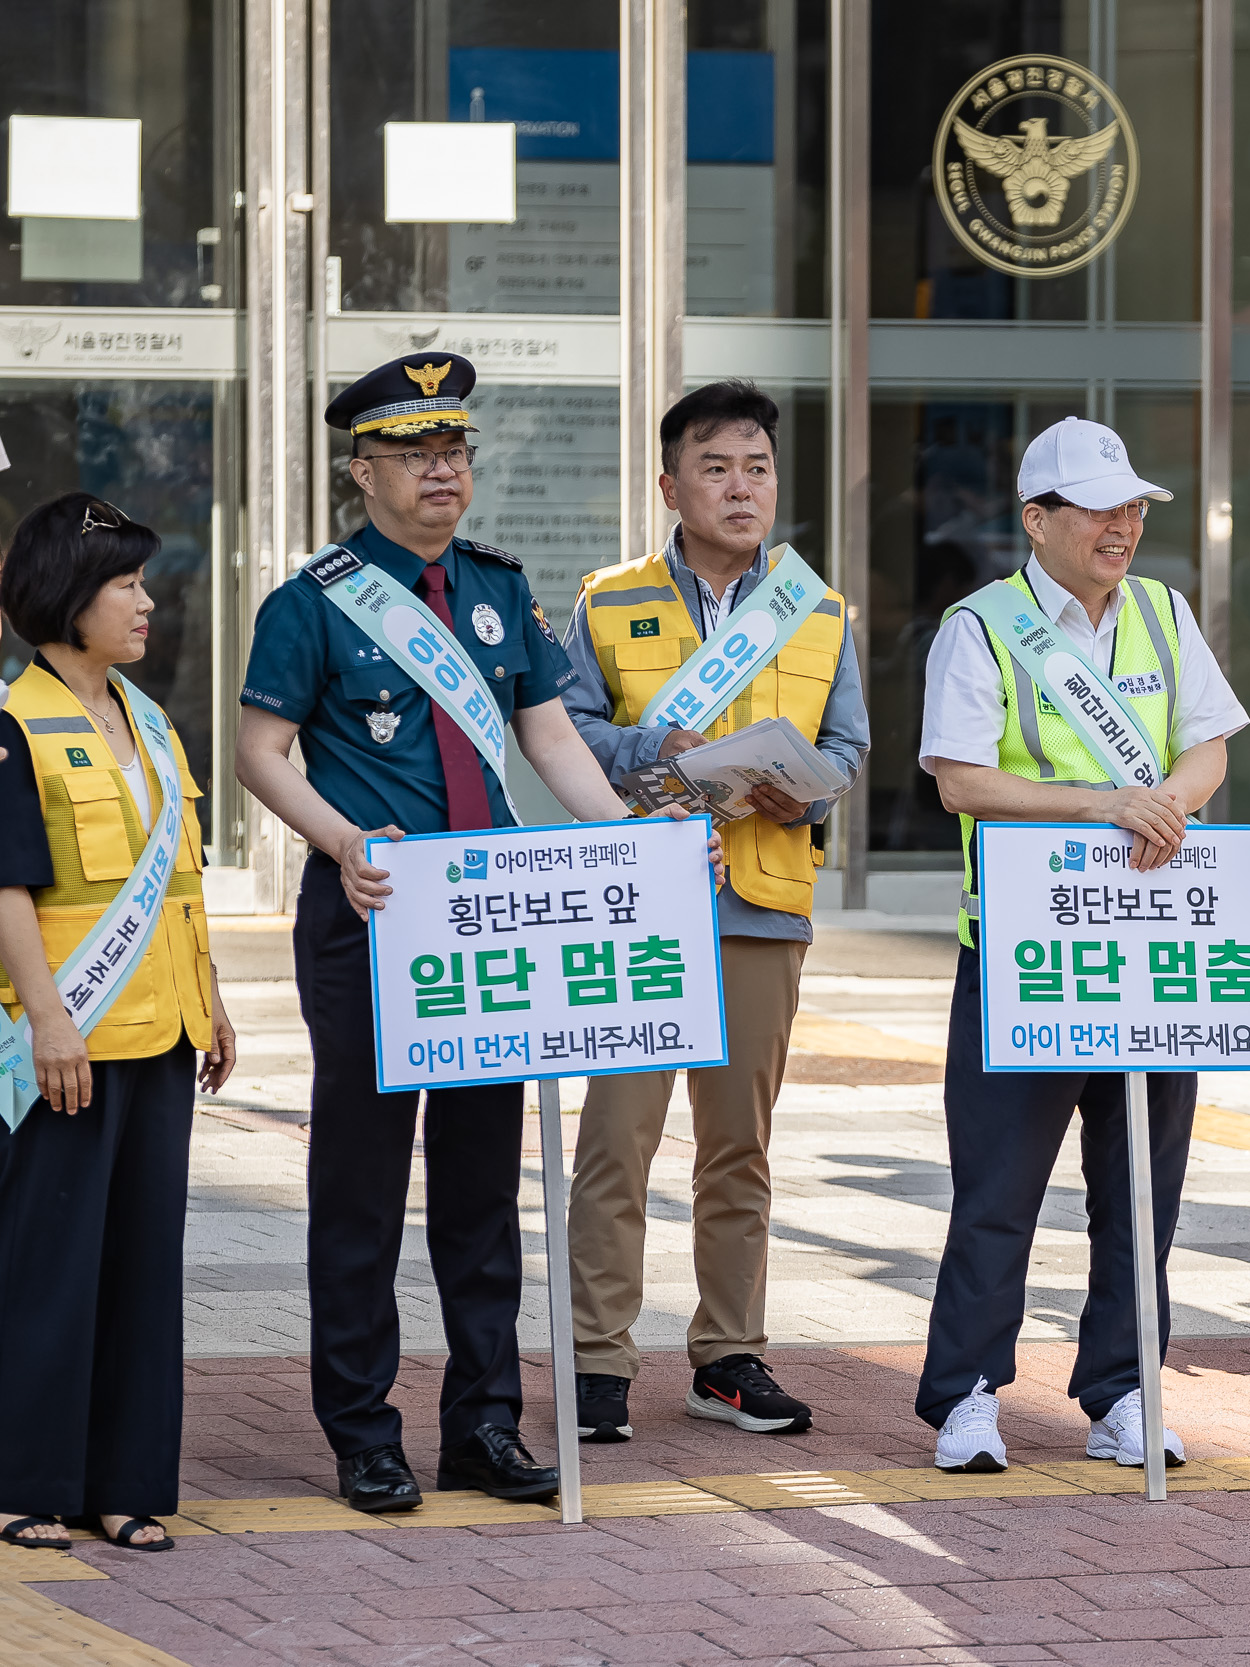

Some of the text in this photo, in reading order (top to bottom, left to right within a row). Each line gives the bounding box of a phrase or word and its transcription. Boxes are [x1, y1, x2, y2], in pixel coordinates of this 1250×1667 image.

[64, 331, 183, 351] 서울광진경찰서
[355, 580, 383, 607] 아이먼저
[368, 591, 391, 613] 캠페인
[769, 598, 789, 622] 캠페인
[774, 585, 798, 617] 아이먼저
[1020, 626, 1049, 648] 아이먼저
[1032, 637, 1056, 656] 캠페인
[407, 626, 468, 692] 아이
[698, 633, 758, 694] 아이
[1063, 673, 1141, 765] 횡단보도
[495, 842, 637, 874] 아이먼저 캠페인
[132, 845, 170, 917] 먼저
[448, 883, 640, 937] 횡단보도 앞
[1050, 884, 1218, 926] 횡단보도 앞
[65, 914, 140, 1018] 보내주세
[409, 935, 686, 1018] 일단 멈춤
[1014, 939, 1126, 1002] 일단
[408, 1021, 694, 1073] 아이 먼저 보내주세요.
[1011, 1023, 1061, 1056] 아이
[1070, 1023, 1120, 1056] 먼저
